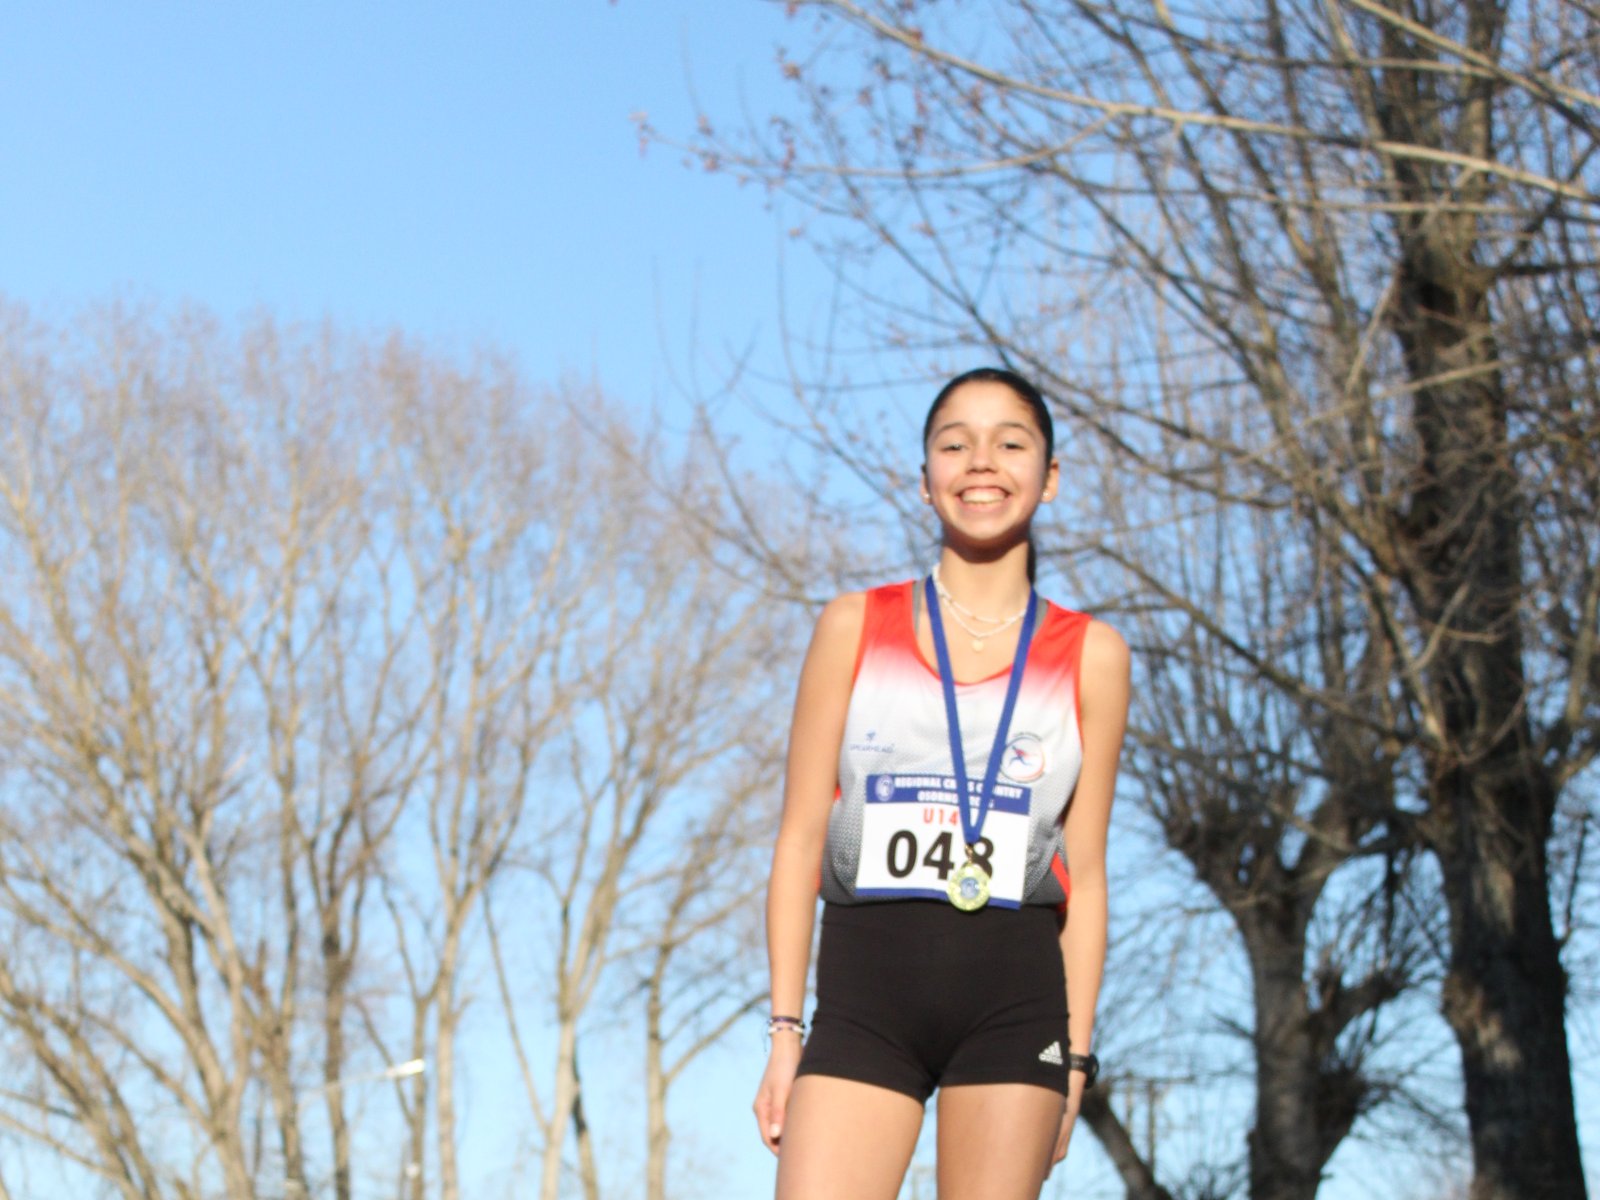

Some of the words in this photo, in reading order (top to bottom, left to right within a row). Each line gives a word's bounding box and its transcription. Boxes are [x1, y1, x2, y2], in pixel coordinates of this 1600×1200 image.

[894, 777, 942, 788] REGIONAL
[923, 807, 959, 826] U14
[886, 829, 994, 881] 048
